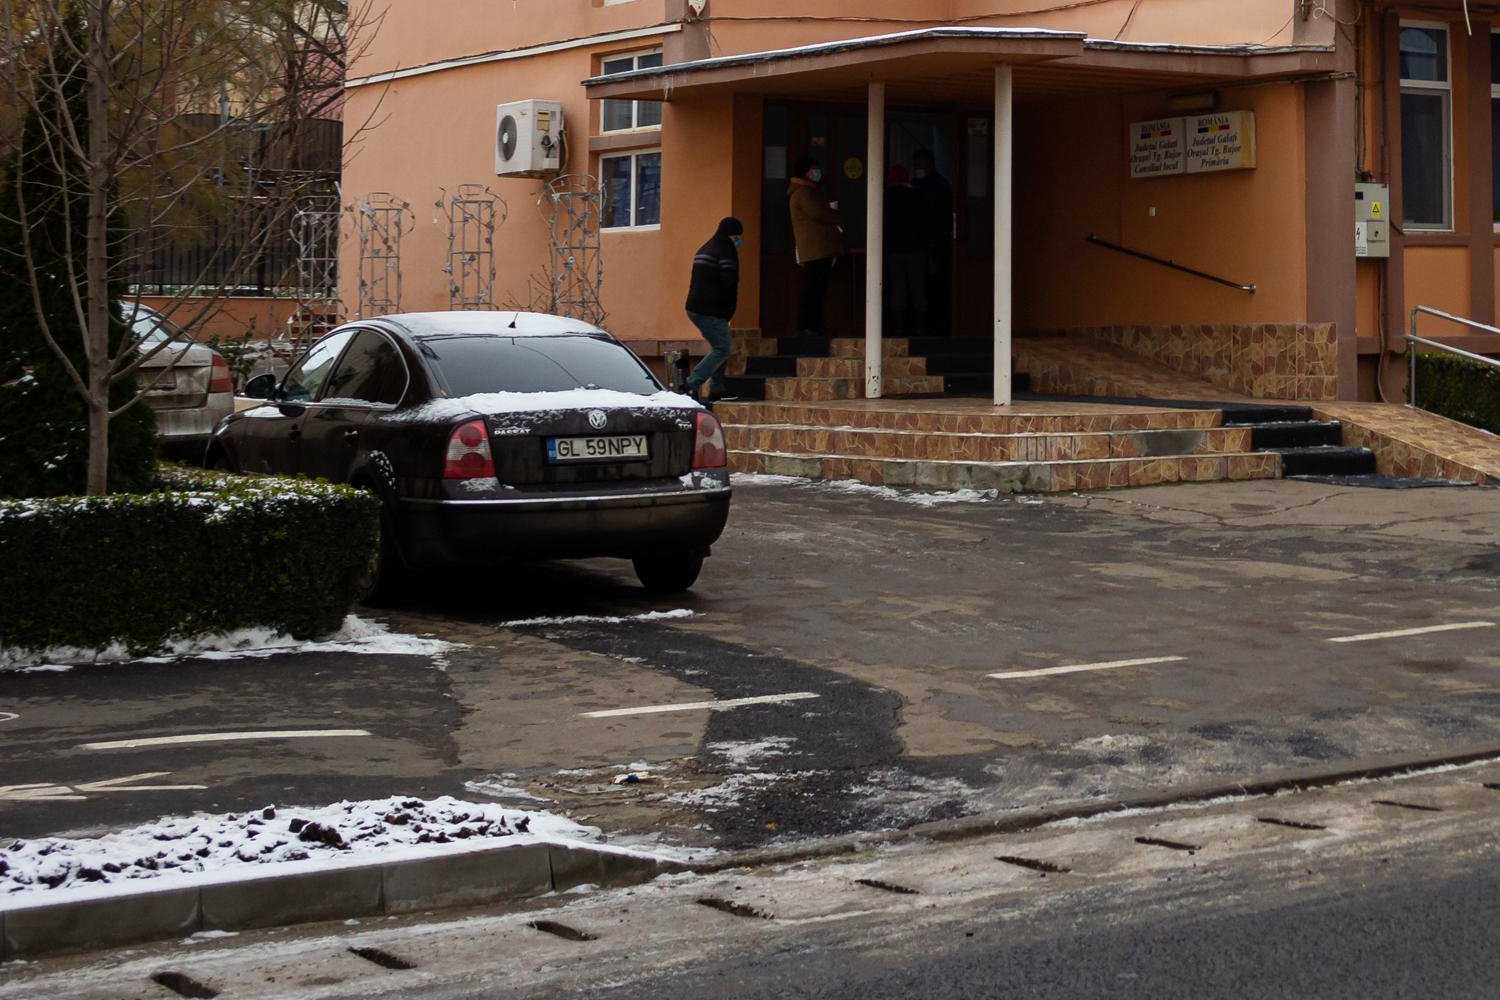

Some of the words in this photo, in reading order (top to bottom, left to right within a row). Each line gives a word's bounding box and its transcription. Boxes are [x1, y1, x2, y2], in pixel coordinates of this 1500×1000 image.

[1164, 149, 1182, 160] Bujor
[1211, 146, 1221, 156] Tg.
[1222, 144, 1242, 156] Bujor
[1164, 160, 1178, 171] local
[557, 440, 580, 457] GL
